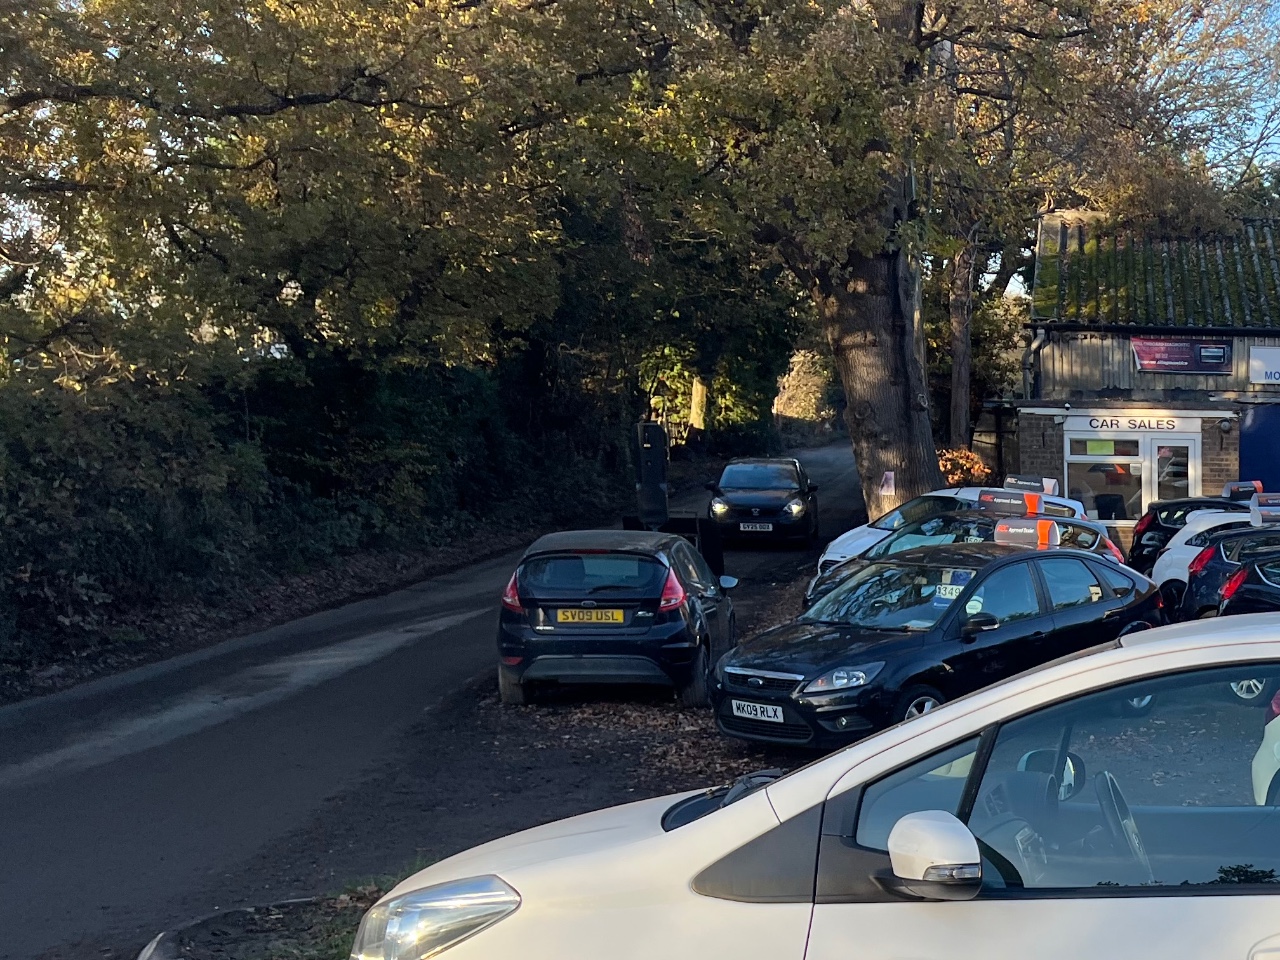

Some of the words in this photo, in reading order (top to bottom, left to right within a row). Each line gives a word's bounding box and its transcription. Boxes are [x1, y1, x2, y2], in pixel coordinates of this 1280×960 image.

[1089, 418, 1120, 429] CAR
[1127, 419, 1176, 430] SALES
[562, 610, 593, 621] SV09
[596, 610, 618, 621] USL
[736, 702, 758, 716] MK09
[760, 706, 779, 719] RLX
